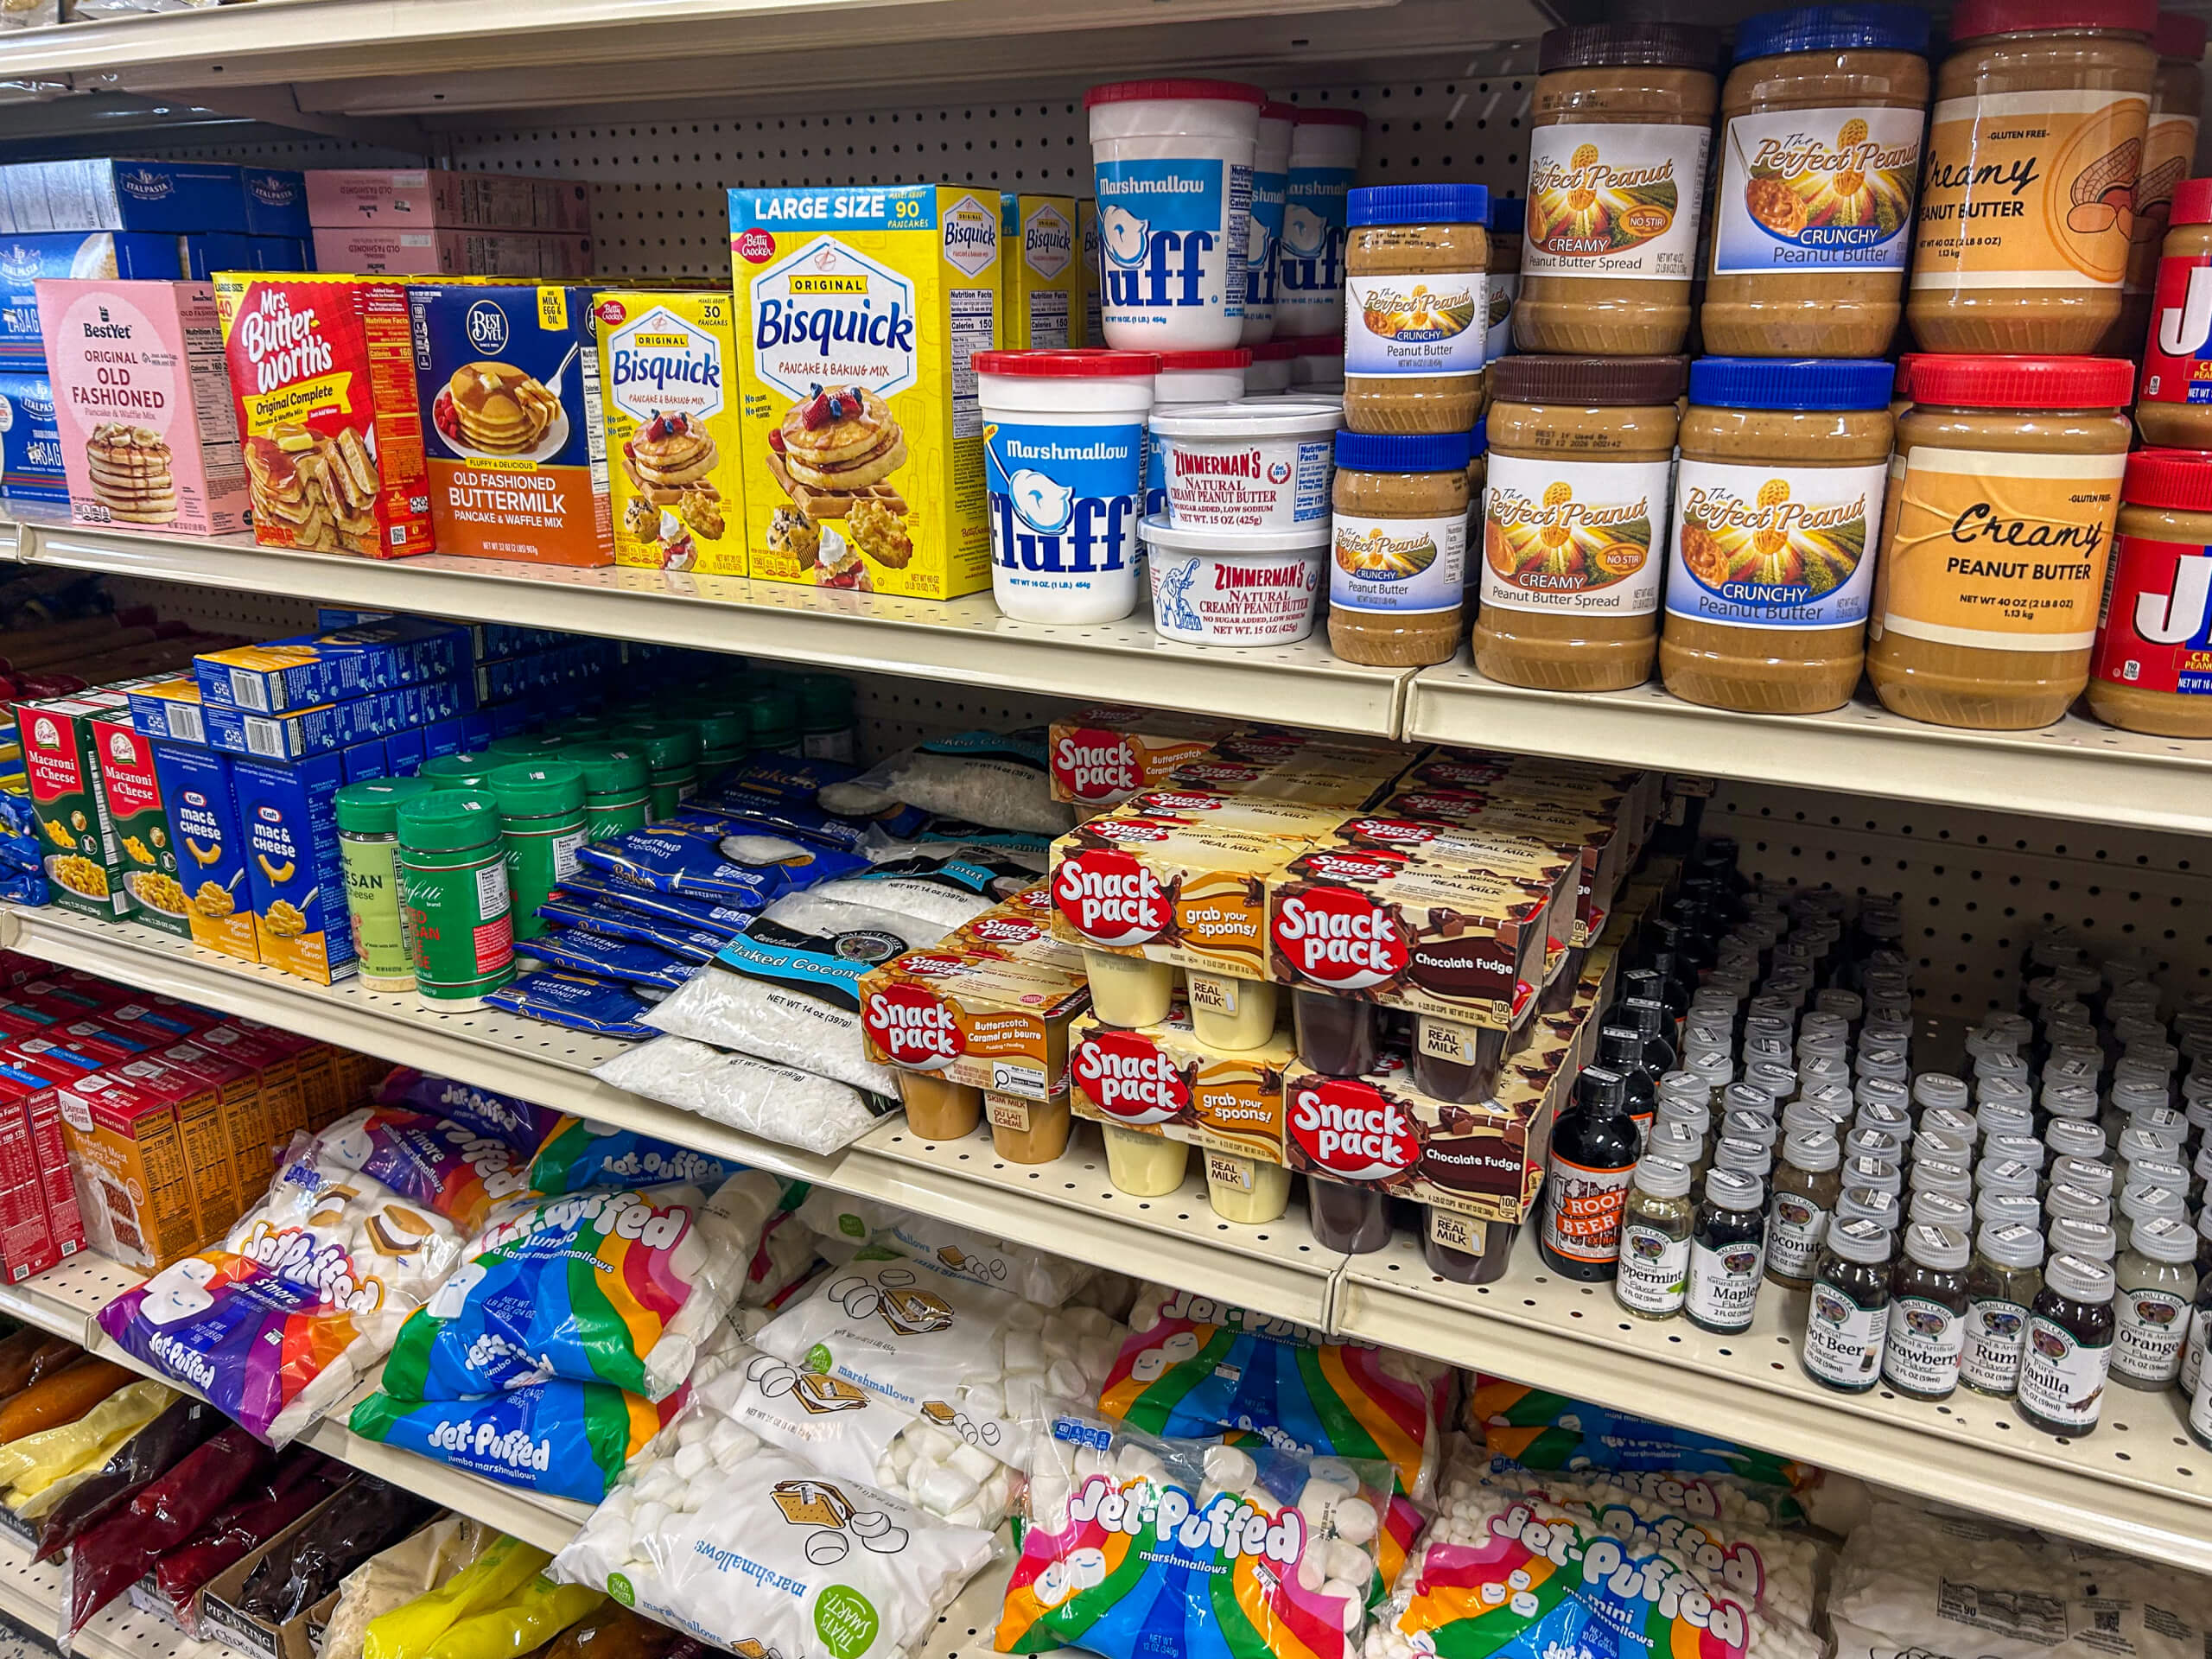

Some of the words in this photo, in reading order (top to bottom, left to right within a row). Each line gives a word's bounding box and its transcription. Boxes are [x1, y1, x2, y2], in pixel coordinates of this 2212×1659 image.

[755, 200, 827, 220] LARGE
[834, 195, 885, 219] SIZE
[895, 200, 918, 218] 90
[887, 219, 928, 229] PANCAKES
[944, 221, 995, 248] Bisquick
[232, 283, 244, 292] SIZE
[794, 278, 862, 291] ORIGINAL
[219, 302, 232, 318] 40
[261, 289, 289, 316] Mrs.
[543, 307, 555, 315] EGG
[704, 306, 720, 319] 30
[83, 323, 130, 339] BestYet
[548, 316, 558, 325] OIL
[698, 319, 728, 327] PANCAKES
[756, 298, 912, 356] Bisquick
[980, 320, 993, 329] 150
[639, 337, 685, 346] ORIGINAL
[85, 351, 138, 364] ORIGINAL
[257, 337, 333, 394] worth's
[98, 368, 130, 385] OLD
[613, 350, 720, 390] Bisquick
[779, 362, 821, 375] PANCAKE
[823, 364, 829, 376] &
[830, 363, 868, 377] BAKING
[869, 365, 890, 377] MIX
[73, 387, 164, 408] FASHIONED
[256, 395, 288, 416] Original
[290, 385, 333, 407] Complete
[1007, 440, 1128, 461] Marshmallow
[1535, 438, 1551, 447] FEB
[499, 461, 533, 470] DELICIOUS
[1173, 448, 1261, 479] ZIMMERMAN'S
[454, 473, 478, 486] OLD
[481, 474, 556, 491] FASHIONED
[1185, 477, 1245, 491] NATURAL
[449, 487, 566, 514] BUTTERMILK
[1172, 490, 1196, 501] CREAMY
[1198, 491, 1236, 503] PEANUT
[1237, 491, 1276, 502] BUTTER
[1488, 486, 1558, 525] Perfect
[1561, 495, 1647, 527] Peanut
[1684, 486, 1773, 530] Perfect
[1776, 492, 1866, 530] Peanut
[1180, 514, 1192, 524] NET
[1194, 515, 1208, 524] WT.
[1213, 516, 1218, 524] 15
[1220, 516, 1234, 524] OZ
[1236, 515, 1262, 525] (425g)
[1951, 503, 2102, 558] Creamy
[1606, 554, 1620, 564] NO
[1622, 554, 1641, 564] STIR
[1947, 557, 2029, 579] PEANUT
[2032, 562, 2091, 580] BUTTER
[1519, 573, 1585, 589] CREAMY
[1723, 582, 1811, 601] CRUNCHY
[1493, 585, 1529, 603] Peanut
[1532, 589, 1571, 606] Butter
[1573, 594, 1620, 608] Spread
[1960, 594, 1978, 605] NET
[1980, 595, 1995, 606] WT
[1998, 597, 2011, 606] 40
[2012, 598, 2027, 607] OZ
[2004, 609, 2019, 620] 1.13
[2022, 611, 2033, 620] kg
[29, 750, 75, 771] Macaroni
[262, 810, 278, 821] Kraft
[254, 823, 276, 841] mac
[278, 830, 290, 843] &
[626, 834, 681, 852] SWEETENED
[628, 842, 671, 860] COCONUT
[1058, 859, 1161, 900] Snack
[1083, 894, 1160, 928] pack
[1186, 907, 1220, 925] grab
[1223, 912, 1248, 924] your
[1281, 897, 1396, 944] Snack
[1198, 918, 1257, 938] spoons!
[726, 937, 788, 968] Flaked
[791, 957, 862, 982] Coconu
[1303, 935, 1397, 970] pack
[1414, 952, 1473, 971] Chocolate
[1476, 958, 1514, 976] Fudge
[766, 993, 784, 1004] NET
[785, 996, 799, 1009] WT
[800, 1003, 810, 1014] 14
[811, 1007, 824, 1019] oz
[825, 1011, 852, 1028] (397g)
[868, 992, 956, 1032] Snack
[1493, 1001, 1509, 1014] 100
[975, 1019, 1029, 1032] Butterscotch
[890, 1025, 958, 1058] pack
[969, 1030, 1001, 1043] Caramel
[1001, 1032, 1012, 1041] au
[1014, 1031, 1041, 1041] beurre
[62, 1099, 86, 1115] Duncan
[987, 1094, 1006, 1107] SKIM
[1007, 1098, 1026, 1109] MILK
[994, 1109, 1002, 1120] DU
[1004, 1111, 1022, 1122] LAIT
[397, 1141, 446, 1195] marshmallows
[1571, 1191, 1625, 1214] ROOT
[1437, 1219, 1466, 1234] REAL
[1562, 1214, 1615, 1236] BEER
[1436, 1230, 1468, 1246] MILK
[254, 1277, 301, 1305] s'more
[1713, 1286, 1756, 1301] Maple
[1827, 1338, 1865, 1357] Beer
[2120, 1329, 2179, 1355] Orange
[147, 1332, 216, 1390] Jet-Puffed
[1976, 1343, 2018, 1364] Rum
[2123, 1355, 2127, 1363] 2
[2138, 1358, 2147, 1368] OZ
[837, 1364, 916, 1405] marshmallows
[2024, 1358, 2069, 1395] Vanilla
[428, 1420, 550, 1471] Jet-Puffed
[448, 1453, 474, 1467] jumbo
[474, 1459, 537, 1481] marshmallows
[1070, 1479, 1302, 1566] Jet-Puffed
[694, 1539, 807, 1598] marshmallows
[1139, 1549, 1228, 1575] marshmallows
[1491, 1507, 1744, 1649] Jet-Puffed
[1562, 1585, 1654, 1648] marshmallows
[1587, 1593, 1635, 1624] mini
[206, 1601, 223, 1620] PIE
[226, 1614, 271, 1648] FILLING
[217, 1629, 263, 1659] Chocola
